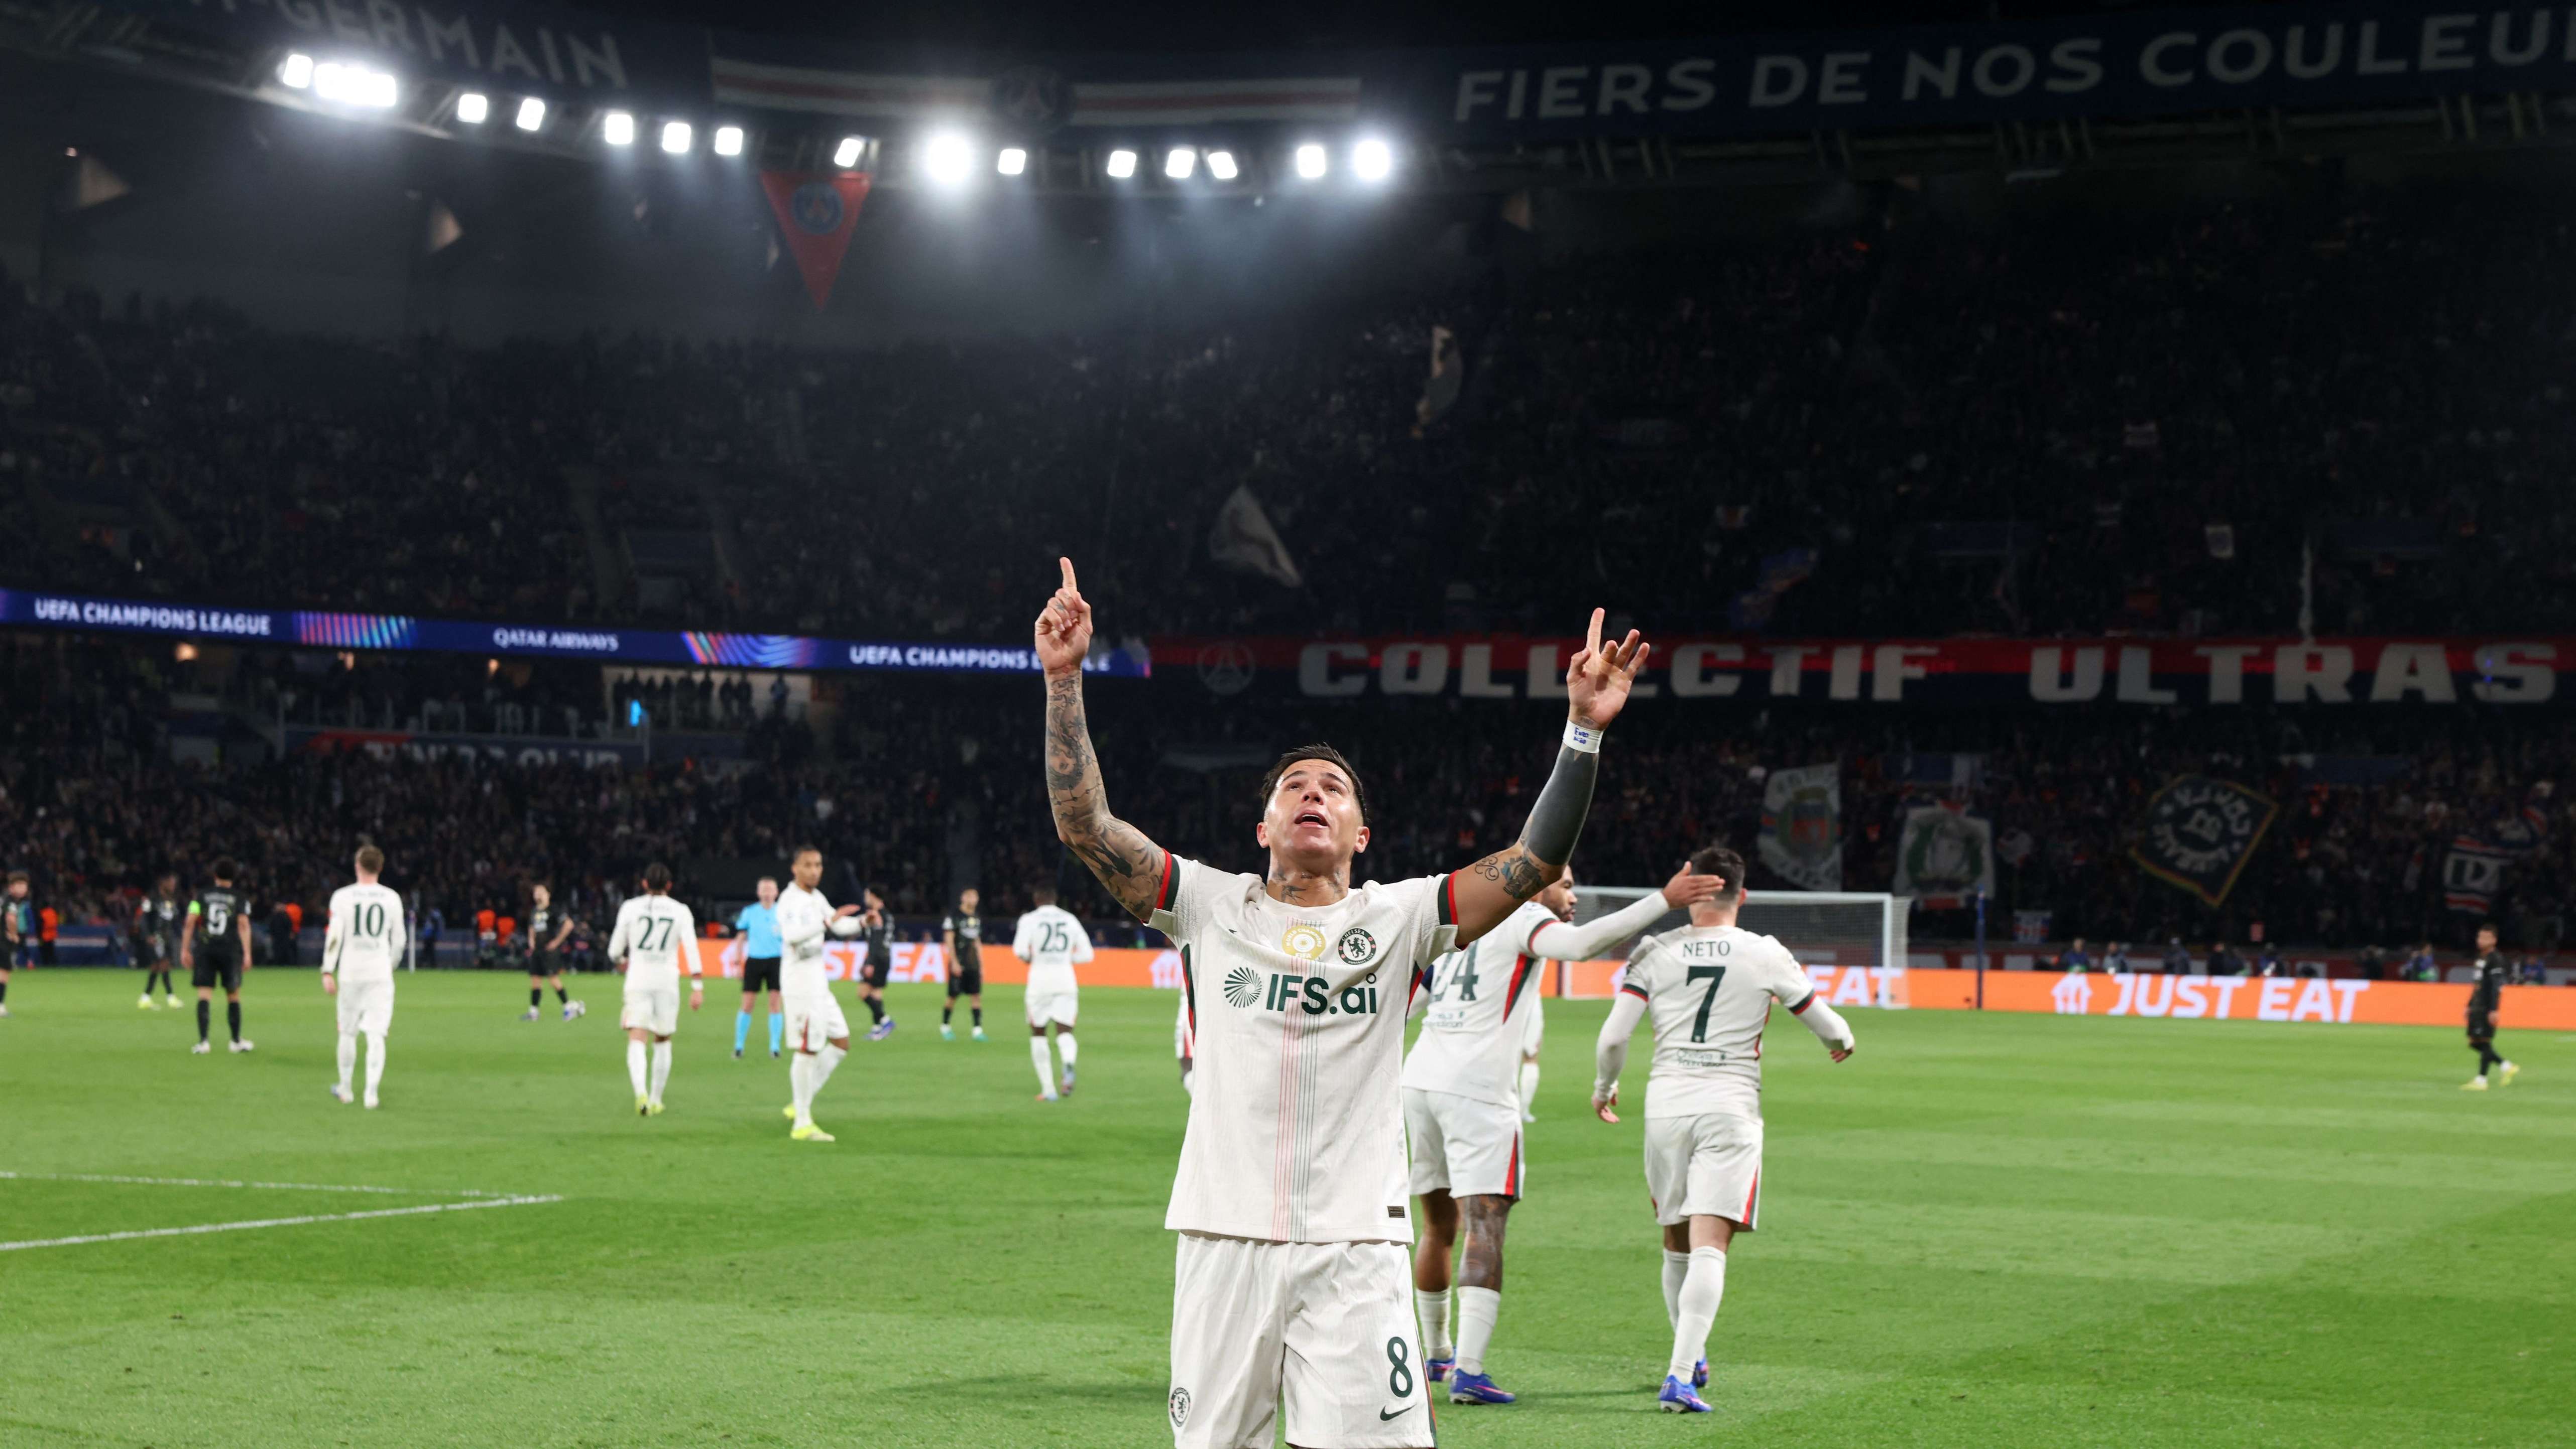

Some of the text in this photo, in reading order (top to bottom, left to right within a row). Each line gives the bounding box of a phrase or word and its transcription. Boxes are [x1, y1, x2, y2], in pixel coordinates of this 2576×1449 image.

[1454, 8, 2576, 122] FIERS DE NOS COULEU
[34, 597, 272, 636] UEFA CHAMPIONS LEAGUE
[493, 628, 619, 652] QATAR AIRWAYS
[849, 645, 902, 666] UEFA
[905, 647, 1028, 670] CHAMPIONS
[2028, 643, 2560, 703] ULTRAS
[353, 902, 384, 938] 10
[637, 915, 674, 952] 27
[1038, 921, 1069, 953] 25
[1341, 928, 1365, 941] CHELSEA
[1683, 941, 1730, 957] NETO
[1265, 972, 1376, 1015] IFS.ai
[1686, 965, 1726, 1043] 7
[2108, 974, 2370, 1023] JUST EAT
[1387, 1337, 1413, 1398] 8
